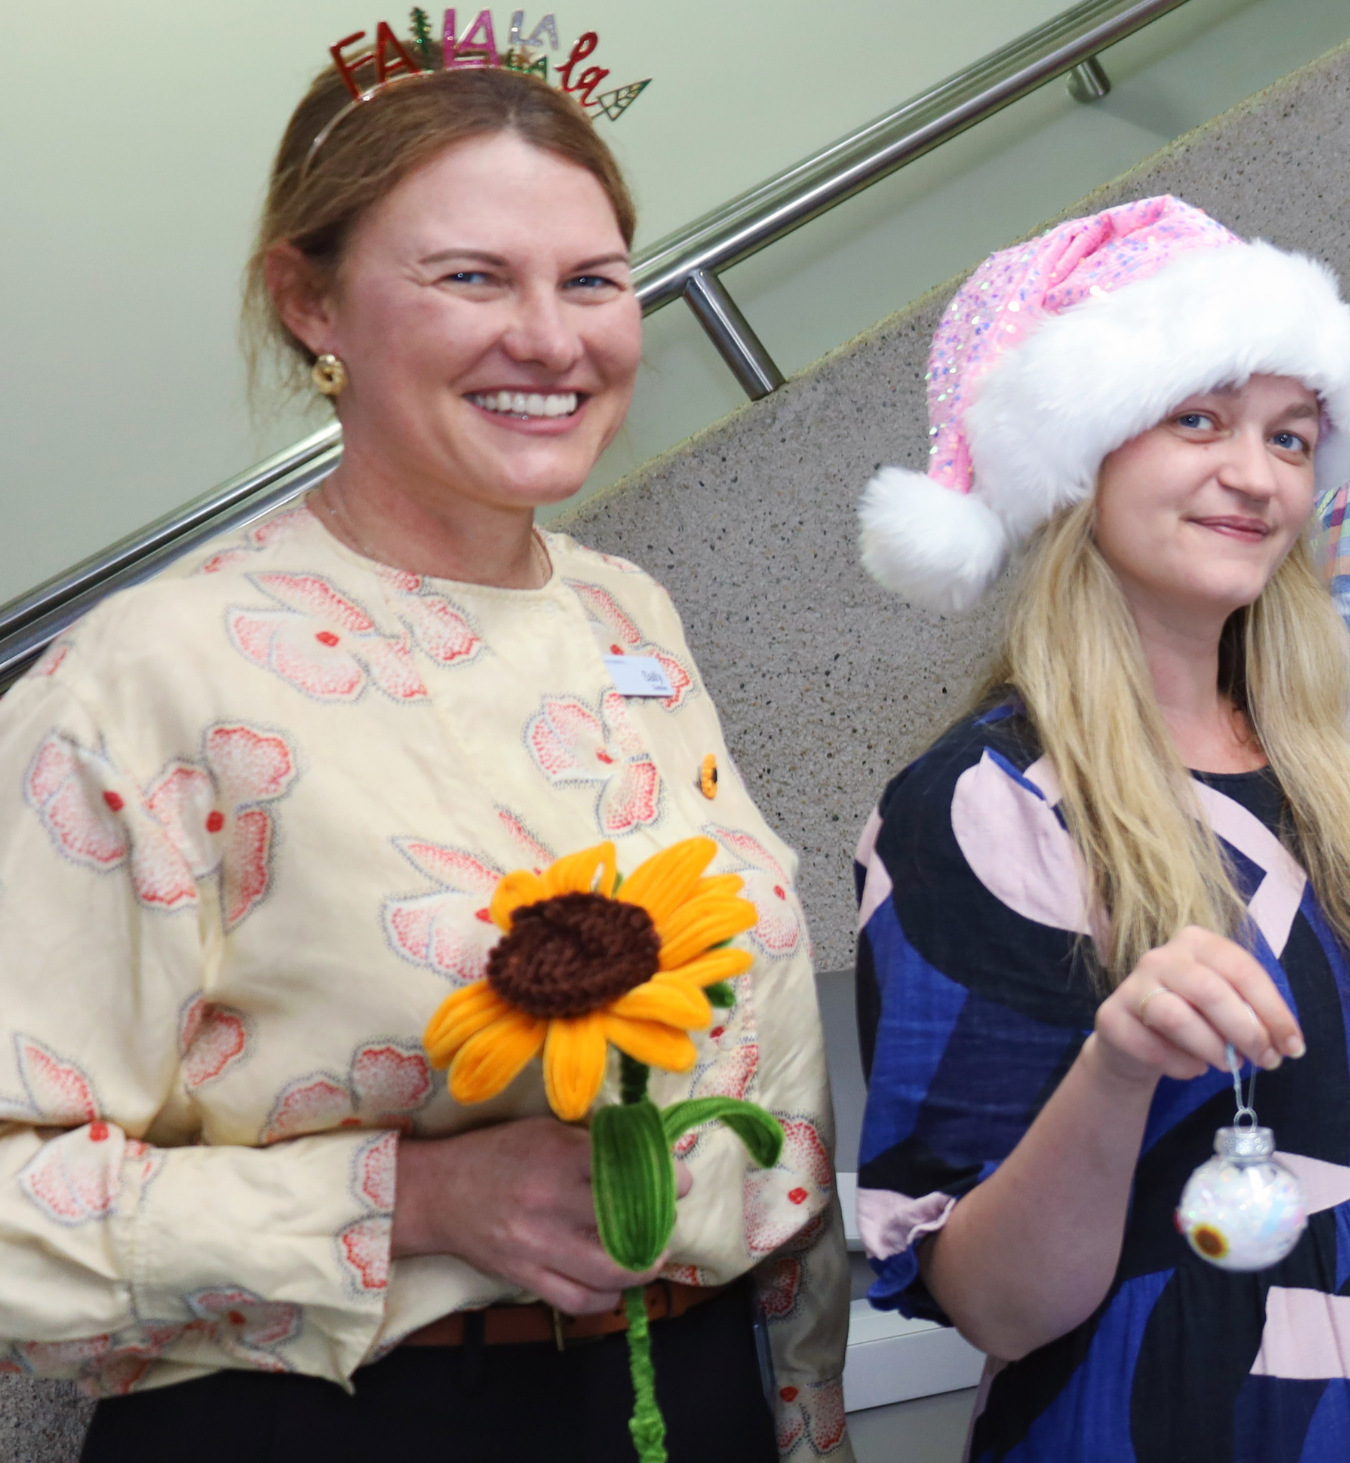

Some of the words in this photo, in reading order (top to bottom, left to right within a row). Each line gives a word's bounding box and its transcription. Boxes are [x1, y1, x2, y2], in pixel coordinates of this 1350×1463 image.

[330, 21, 422, 100] FA
[442, 8, 499, 68] LA
[508, 8, 559, 51] LA
